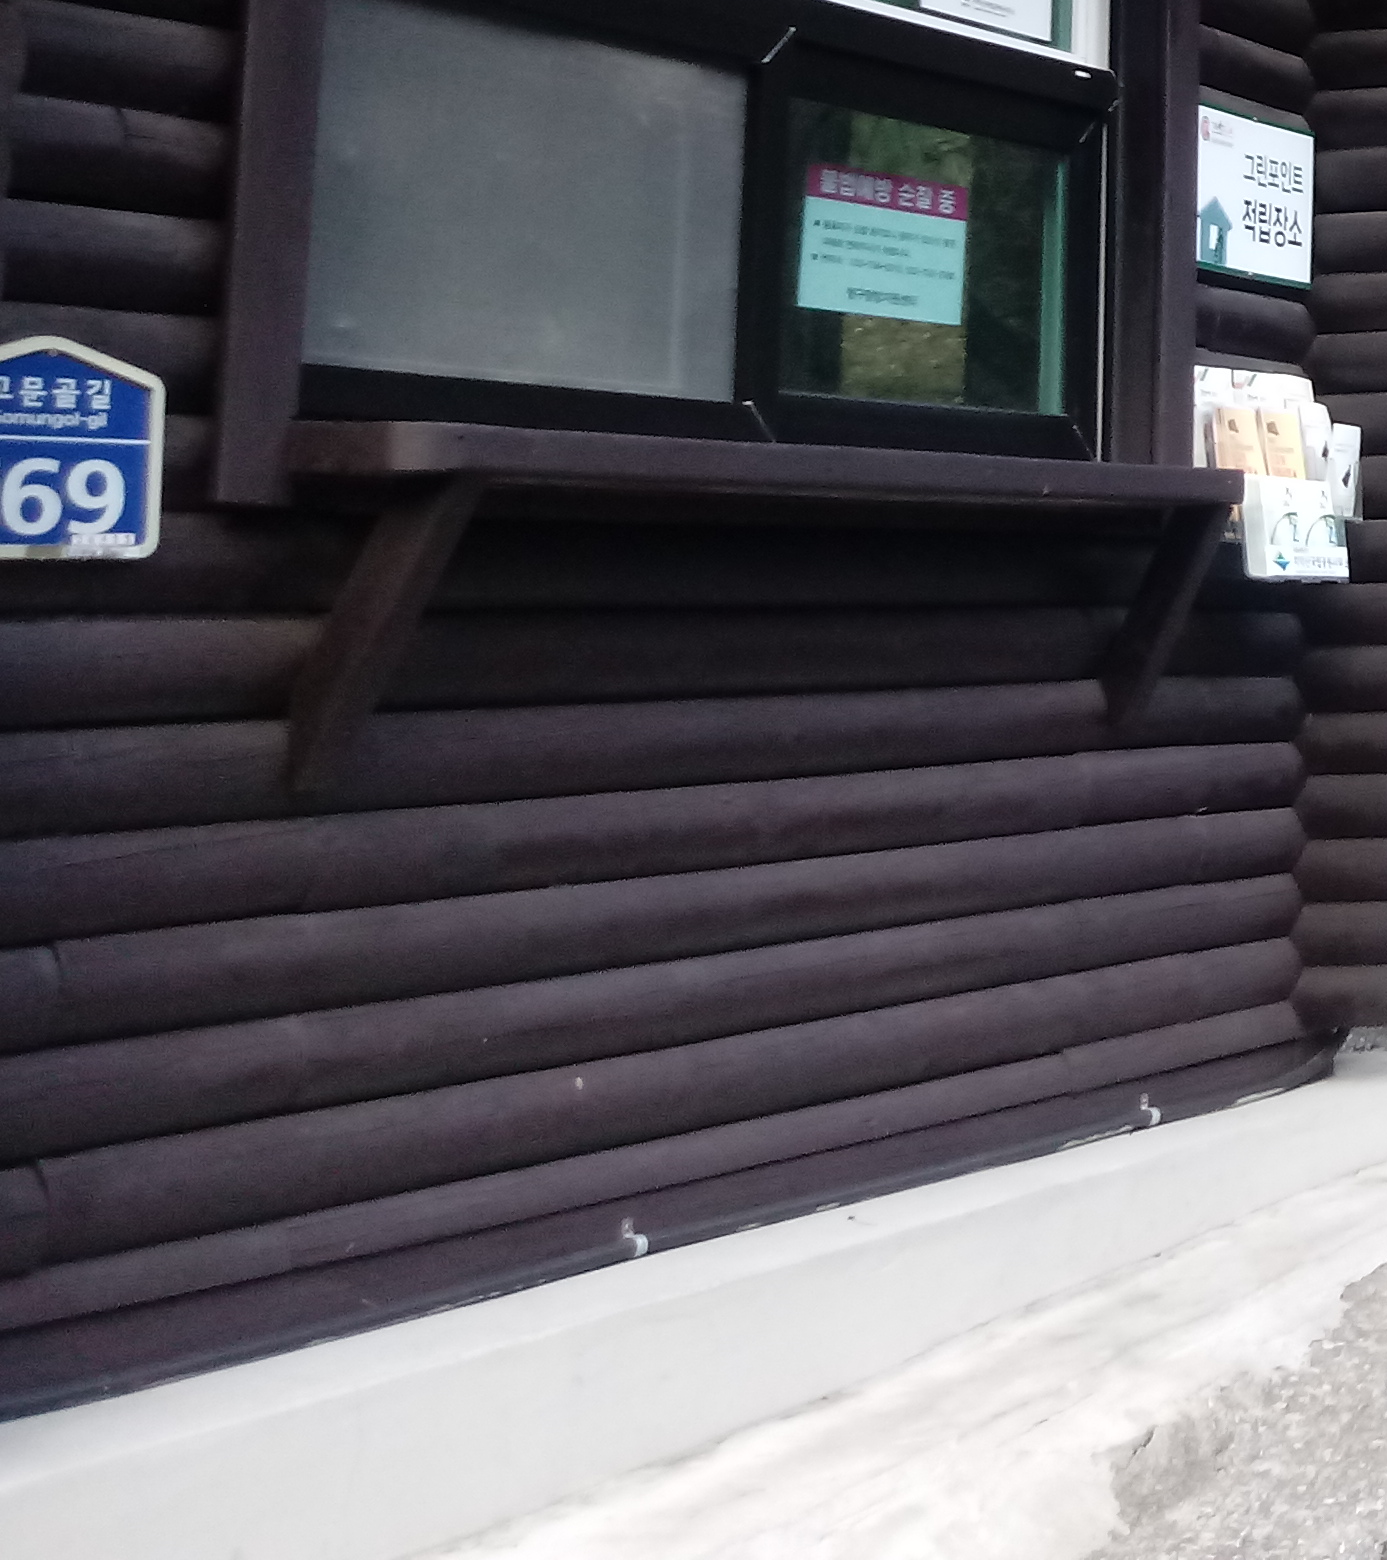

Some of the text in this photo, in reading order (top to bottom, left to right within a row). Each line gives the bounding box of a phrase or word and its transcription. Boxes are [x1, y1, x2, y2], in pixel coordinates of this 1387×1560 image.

[1243, 153, 1304, 193] 그린포인트
[1242, 199, 1303, 248] 적립장소
[2, 458, 126, 536] 69
